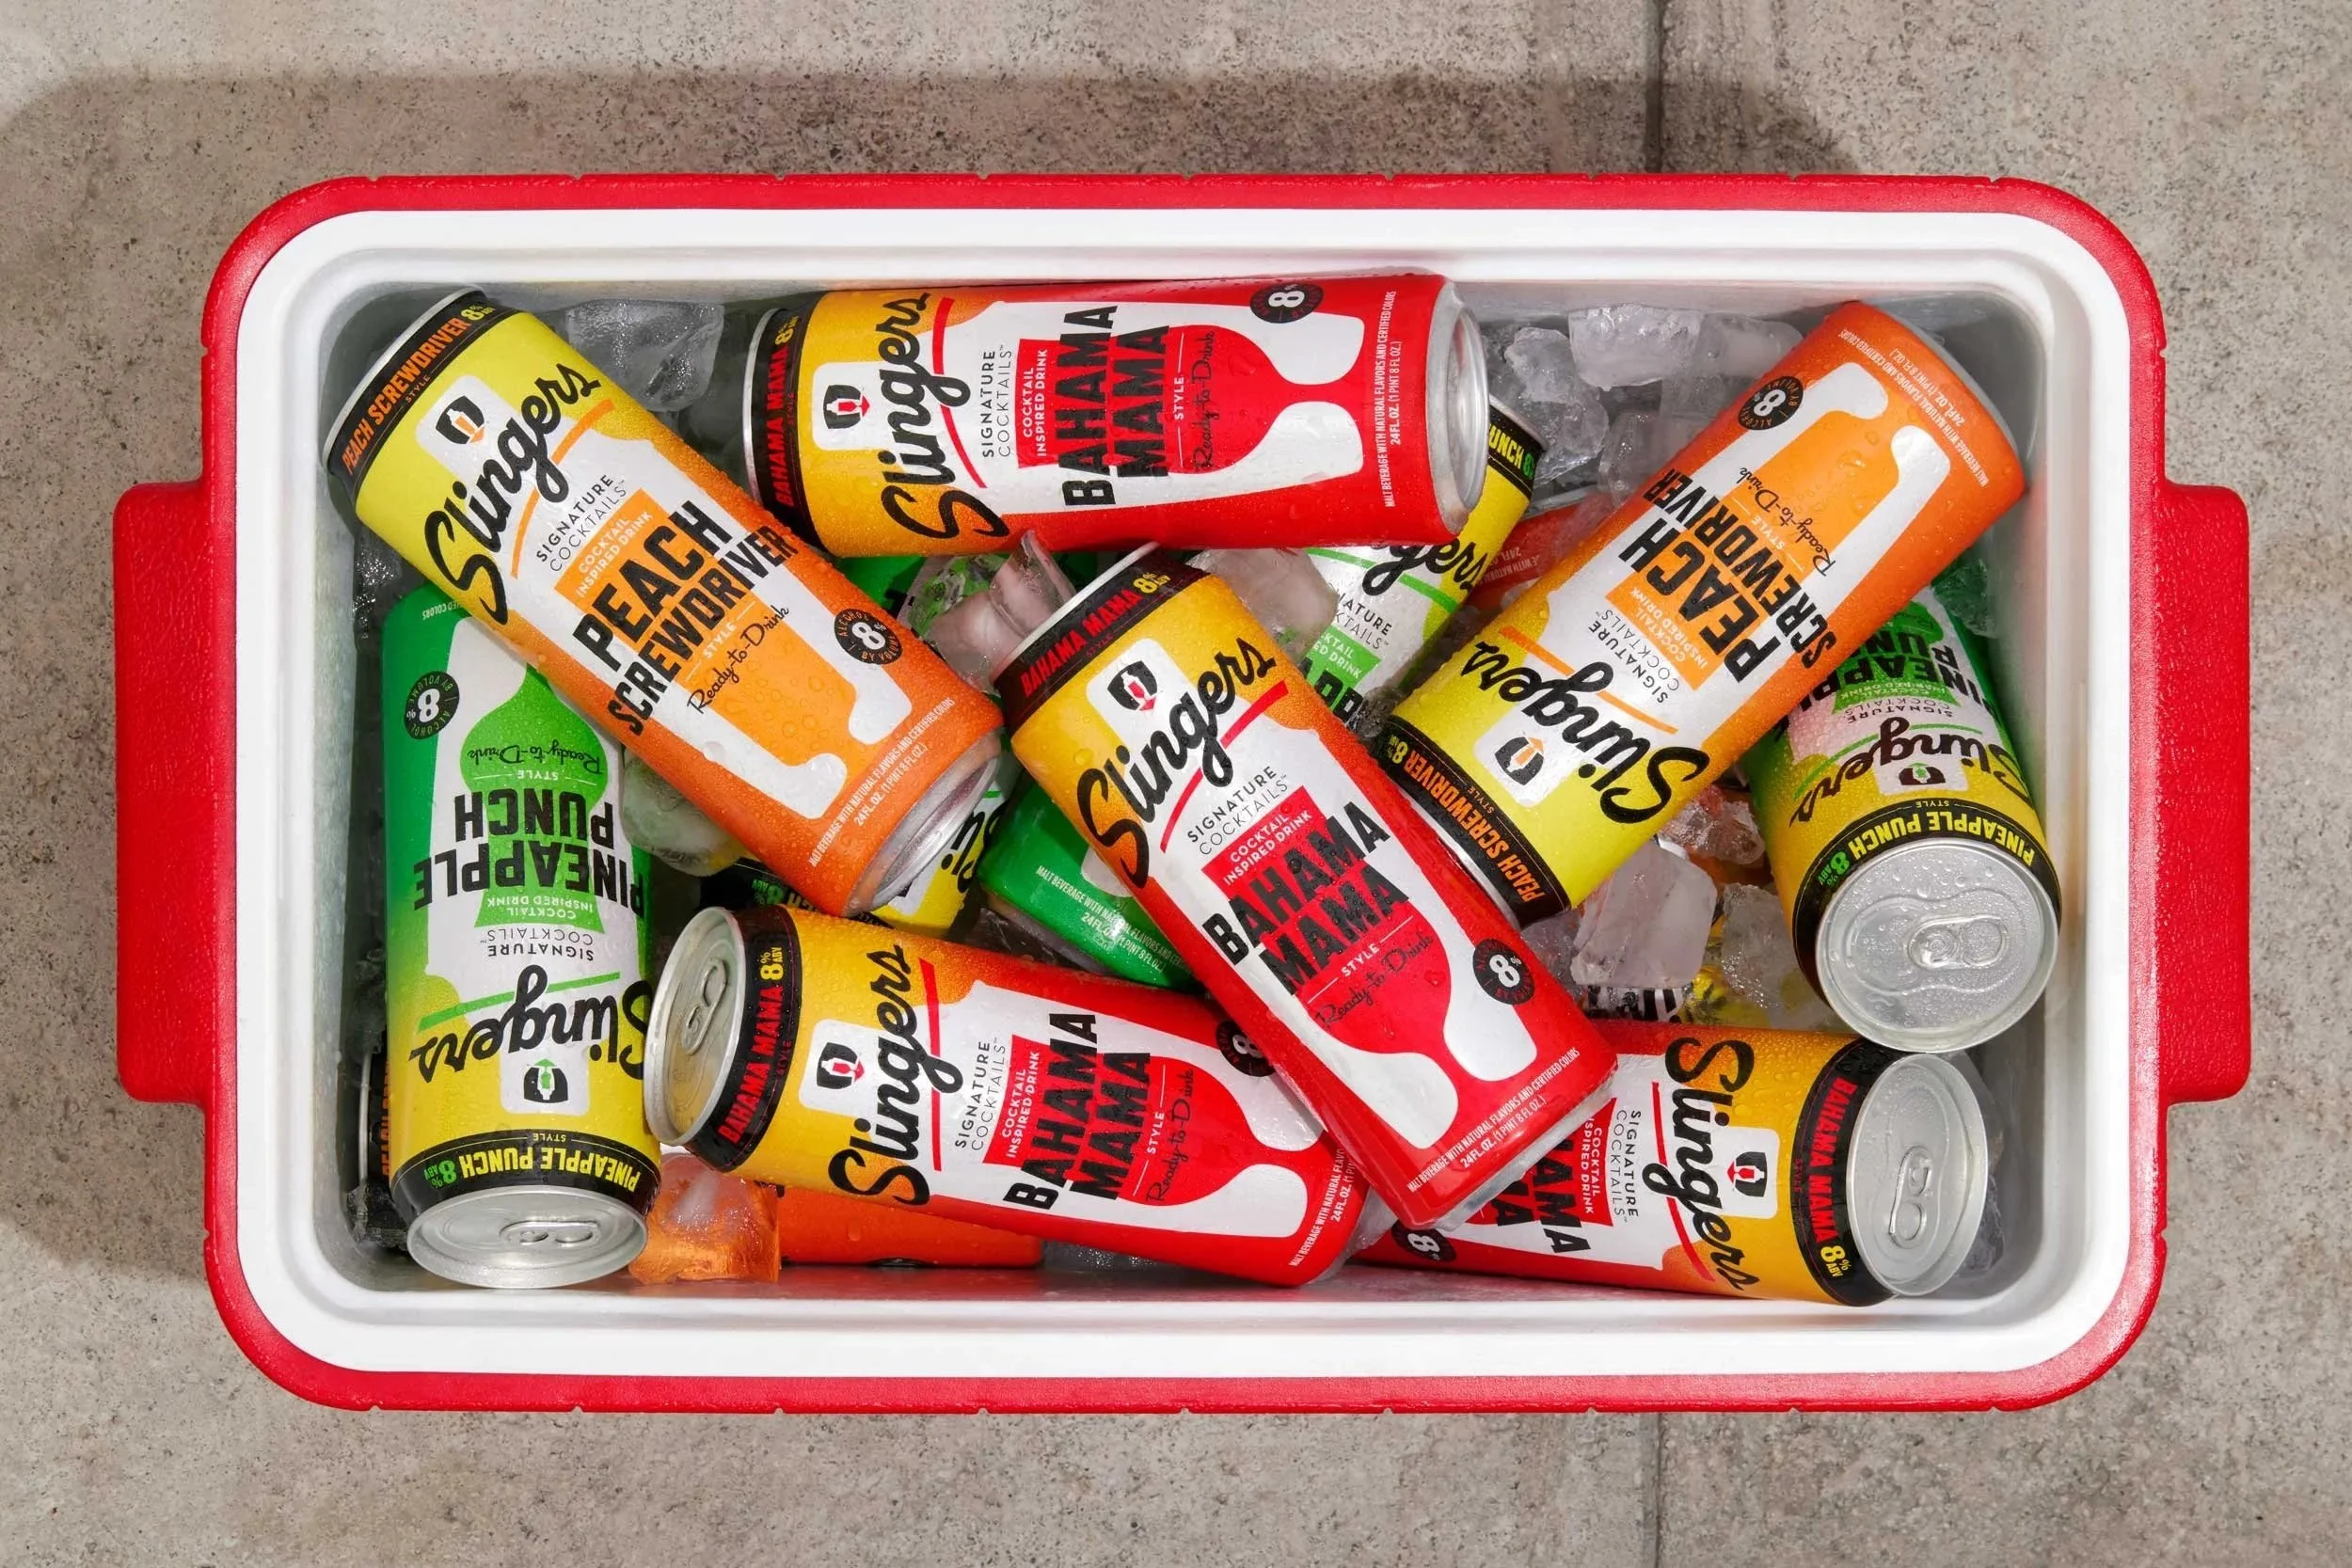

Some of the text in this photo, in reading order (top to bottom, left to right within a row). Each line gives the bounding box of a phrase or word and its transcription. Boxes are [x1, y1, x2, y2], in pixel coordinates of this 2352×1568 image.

[1377, 311, 1391, 343] CERTIFIED
[1382, 291, 1397, 311] COLORS
[1375, 344, 1387, 359] AND
[1375, 360, 1385, 394] FLAVORS
[1389, 374, 1399, 393] PINT
[342, 317, 471, 475] PEACH SCREWDRIVER
[405, 374, 431, 404] STYLE
[875, 292, 1009, 539] Slingers
[980, 351, 995, 458] SIGNATURE
[1023, 368, 1033, 438] COCKTAIL
[1036, 349, 1048, 457] INSPIRED DRINK
[1054, 305, 1118, 506] BAHAMA
[1112, 325, 1169, 478] MAMA
[1174, 376, 1184, 420] STYLE
[1375, 396, 1385, 431] NATURAL
[1896, 373, 1922, 401] FLAVORS
[1921, 398, 1946, 427] NATURAL
[765, 345, 794, 507] BAHAMA MAMA
[1375, 433, 1388, 453] WITH
[1943, 425, 1959, 443] WITH
[424, 363, 602, 626] Slingers
[1377, 454, 1391, 490] BEVERAGE
[536, 474, 613, 562] SIGNATURE
[579, 517, 632, 574] COCKTAIL
[1752, 515, 1787, 550] STYLE
[572, 500, 732, 673] PEACH
[576, 511, 654, 598] INSPIRED DRINK
[1643, 468, 1837, 668] SCREWDRIVER
[607, 526, 799, 735] SCREWDRIVER
[1337, 590, 1392, 636] NATURE
[1618, 517, 1781, 683] PEACH
[1629, 586, 1708, 669] INSPIRED DRINK
[1636, 606, 1686, 661] COCKTAIL
[703, 622, 737, 659] STYLE
[1020, 588, 1144, 698] BAHAMA MAMA
[1322, 633, 1354, 658] KTAIL
[1329, 652, 1363, 678] DRINK
[1588, 620, 1668, 704] SIGNATURE
[1460, 641, 1710, 823] Slingers
[1848, 705, 1953, 723] SIGNATURE
[516, 769, 559, 781] STYLE
[850, 779, 877, 806] NATURAL
[874, 750, 900, 777] FLAVORS
[1077, 638, 1276, 888] Slingers
[1789, 716, 2034, 828] Slingers
[454, 788, 614, 849] PUNCH
[1187, 766, 1277, 843] SIGNATURE
[1403, 751, 1545, 902] PEACH SCREWDRIVER
[1468, 786, 1495, 814] STYLE
[1915, 800, 1950, 809] STYLE
[1224, 811, 1312, 885] INSPIRED DRINK
[1230, 813, 1289, 863] COCKTAIL
[1848, 811, 1922, 860] PUNCH
[1926, 811, 2036, 866] PINEAPPLE
[414, 840, 644, 919] PINEAPPLE
[487, 895, 593, 912] INSPIRED DRINK
[506, 907, 576, 919] COCKTAIL
[1037, 866, 1102, 913] MALT BEVERAGE WITH
[1201, 801, 1391, 966] BAHAMA
[488, 945, 594, 961] SIGNATURE
[1259, 864, 1409, 996] MAMA
[1341, 944, 1380, 977] STYLE
[408, 964, 654, 1084] Slingers
[717, 1061, 771, 1145] BAHAMA
[751, 985, 783, 1055] MAMA
[828, 944, 963, 1205] Slingers
[954, 1041, 990, 1148] SIGNATURE
[533, 1133, 566, 1142] STYLE
[1001, 1068, 1026, 1138] COCKTAIL
[1002, 1013, 1098, 1210] BAHAMA
[1005, 1051, 1040, 1159] INSPIRED DRINK
[1069, 1053, 1151, 1200] MAMA
[1147, 1112, 1165, 1154] STYLE
[1407, 1049, 1579, 1192] MALT BEVERAGE WITH NATURAL FLAVORS AND CERTIFIED COLORS
[1501, 1117, 1518, 1134] PINT
[1520, 1108, 1533, 1118] FL
[1810, 1077, 1857, 1167] BAHAMA
[459, 1147, 533, 1178] PUNCH
[541, 1147, 642, 1192] PINEAPPLE
[1534, 1139, 1590, 1253] AMA
[1581, 1117, 1595, 1214] SPIRED DRINK
[1592, 1127, 1602, 1196] COCKTAIL
[1625, 1110, 1641, 1217] SIGNATURE
[1642, 1037, 1760, 1291] Slingers
[1289, 1176, 1340, 1267] MALT BEVERAGE WITH NATURAL
[1808, 1175, 1839, 1242] MAMA
